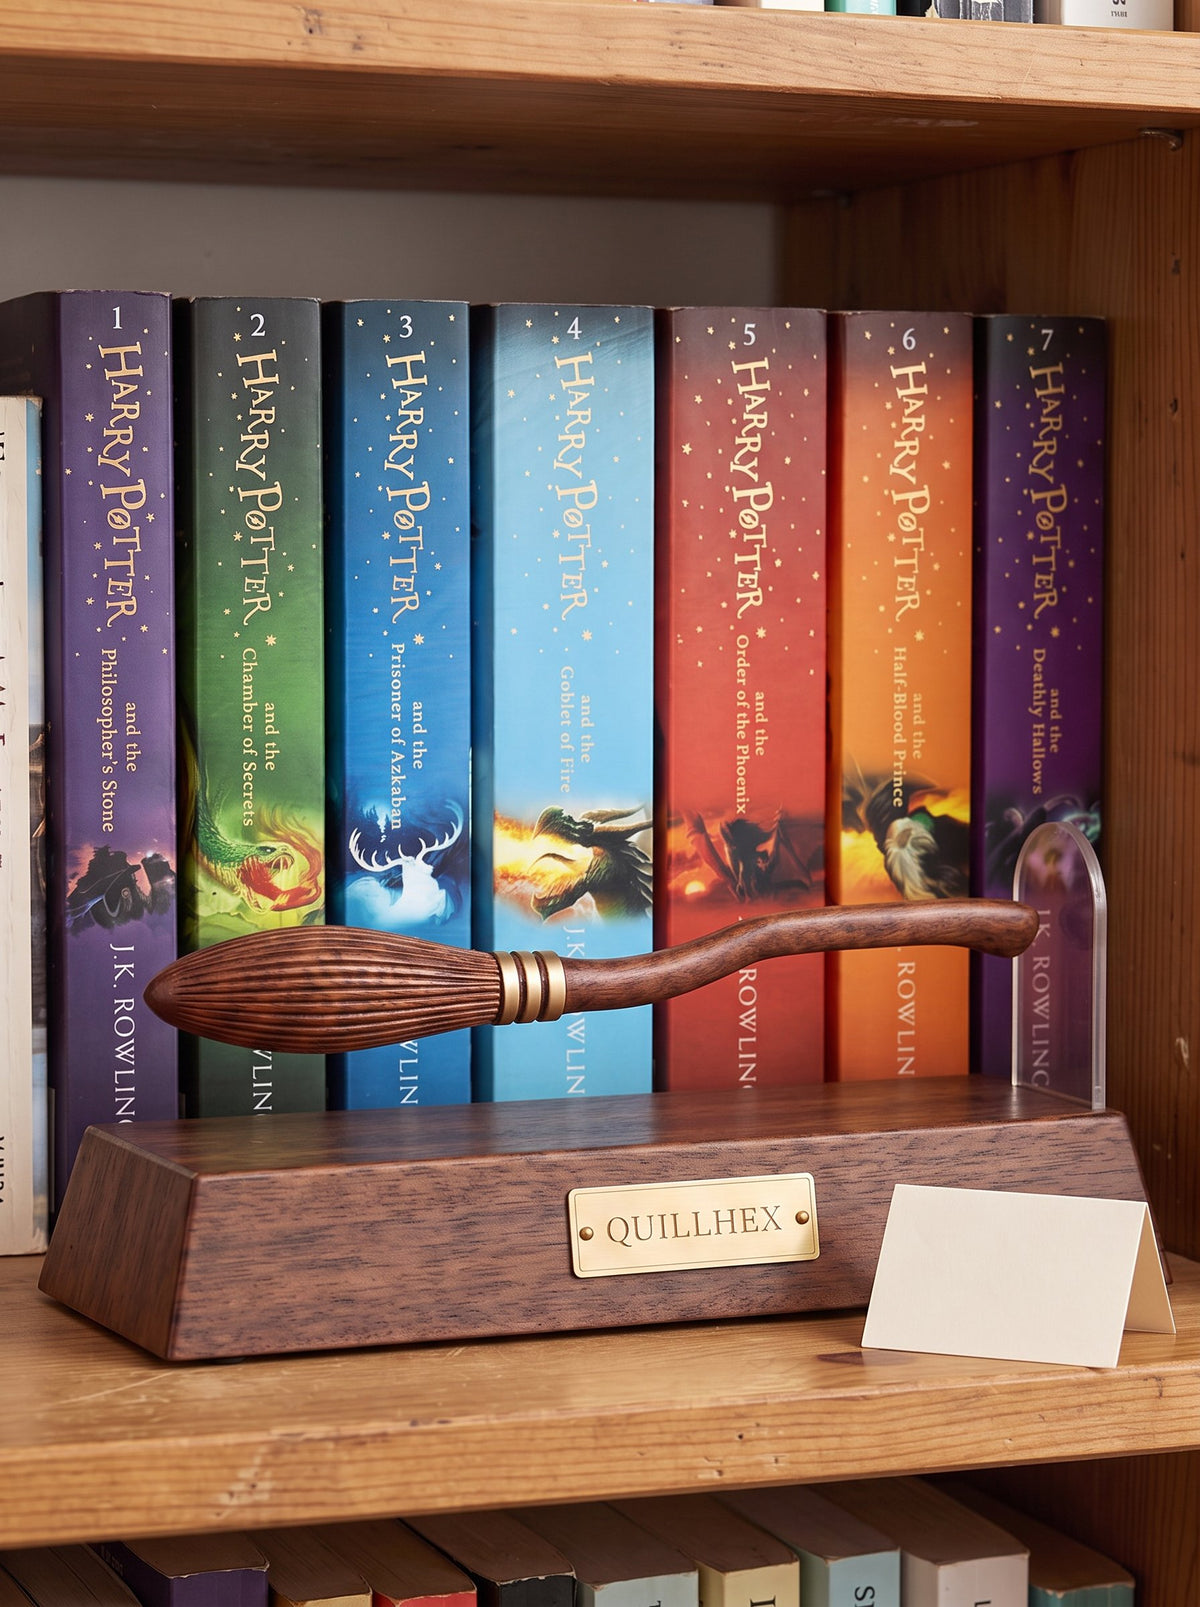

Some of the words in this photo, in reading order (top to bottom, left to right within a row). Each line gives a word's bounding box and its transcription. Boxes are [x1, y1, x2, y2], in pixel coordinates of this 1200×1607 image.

[112, 306, 123, 329] 1
[250, 313, 266, 337] 2
[399, 315, 413, 338] 3
[567, 317, 582, 340] 4
[743, 323, 756, 346] 5
[902, 328, 916, 351] 6
[1040, 329, 1054, 351] 7
[98, 341, 144, 477] HARRY
[235, 349, 280, 481] HARRY
[384, 350, 428, 480] HARRY
[554, 351, 595, 479] HARRY
[730, 357, 771, 483] HARRY
[889, 361, 929, 485] HARRY
[1028, 362, 1065, 484] HARRY
[99, 479, 147, 628] POTTER
[237, 481, 283, 626] POTTER
[385, 481, 431, 624] POTTER
[555, 479, 599, 621] POTTER
[731, 482, 774, 619] POTTER
[890, 484, 931, 623] POTTER
[1030, 483, 1068, 620] POTTER
[391, 643, 406, 722] Prisoner
[736, 635, 750, 686] Order
[1028, 648, 1046, 718] Deathly
[97, 649, 118, 774] Philosopher's
[242, 648, 258, 733] Chamber
[561, 666, 575, 728] Goblet
[581, 695, 595, 727] and
[736, 691, 750, 708] of
[755, 692, 769, 723] and
[893, 646, 907, 745] Half-Blood
[913, 693, 927, 727] and
[1050, 688, 1063, 722] and
[125, 703, 141, 736] and
[265, 703, 280, 735] and
[391, 727, 406, 745] of
[413, 702, 427, 734] and
[561, 733, 575, 752] of
[736, 711, 750, 739] the
[755, 729, 769, 756] the
[1050, 727, 1063, 754] the
[126, 743, 141, 772] the
[243, 737, 258, 756] of
[265, 742, 280, 771] the
[413, 740, 427, 769] the
[581, 734, 595, 763] the
[913, 733, 927, 760] the
[1032, 723, 1046, 795] Hallows
[243, 760, 257, 826] Secrets
[391, 750, 406, 830] Azkaban
[561, 757, 575, 793] Fire
[736, 744, 750, 814] Phoenix
[893, 749, 907, 808] Prince
[102, 780, 119, 832] Stone
[110, 943, 135, 988] J.K.
[563, 926, 585, 958] J.K
[738, 968, 757, 1089] ROWLIN
[897, 961, 916, 1076] ROWLIN
[114, 998, 136, 1123] ROWLIN
[566, 1012, 585, 1095] WLIN
[606, 1205, 782, 1247] QUILLHEX
